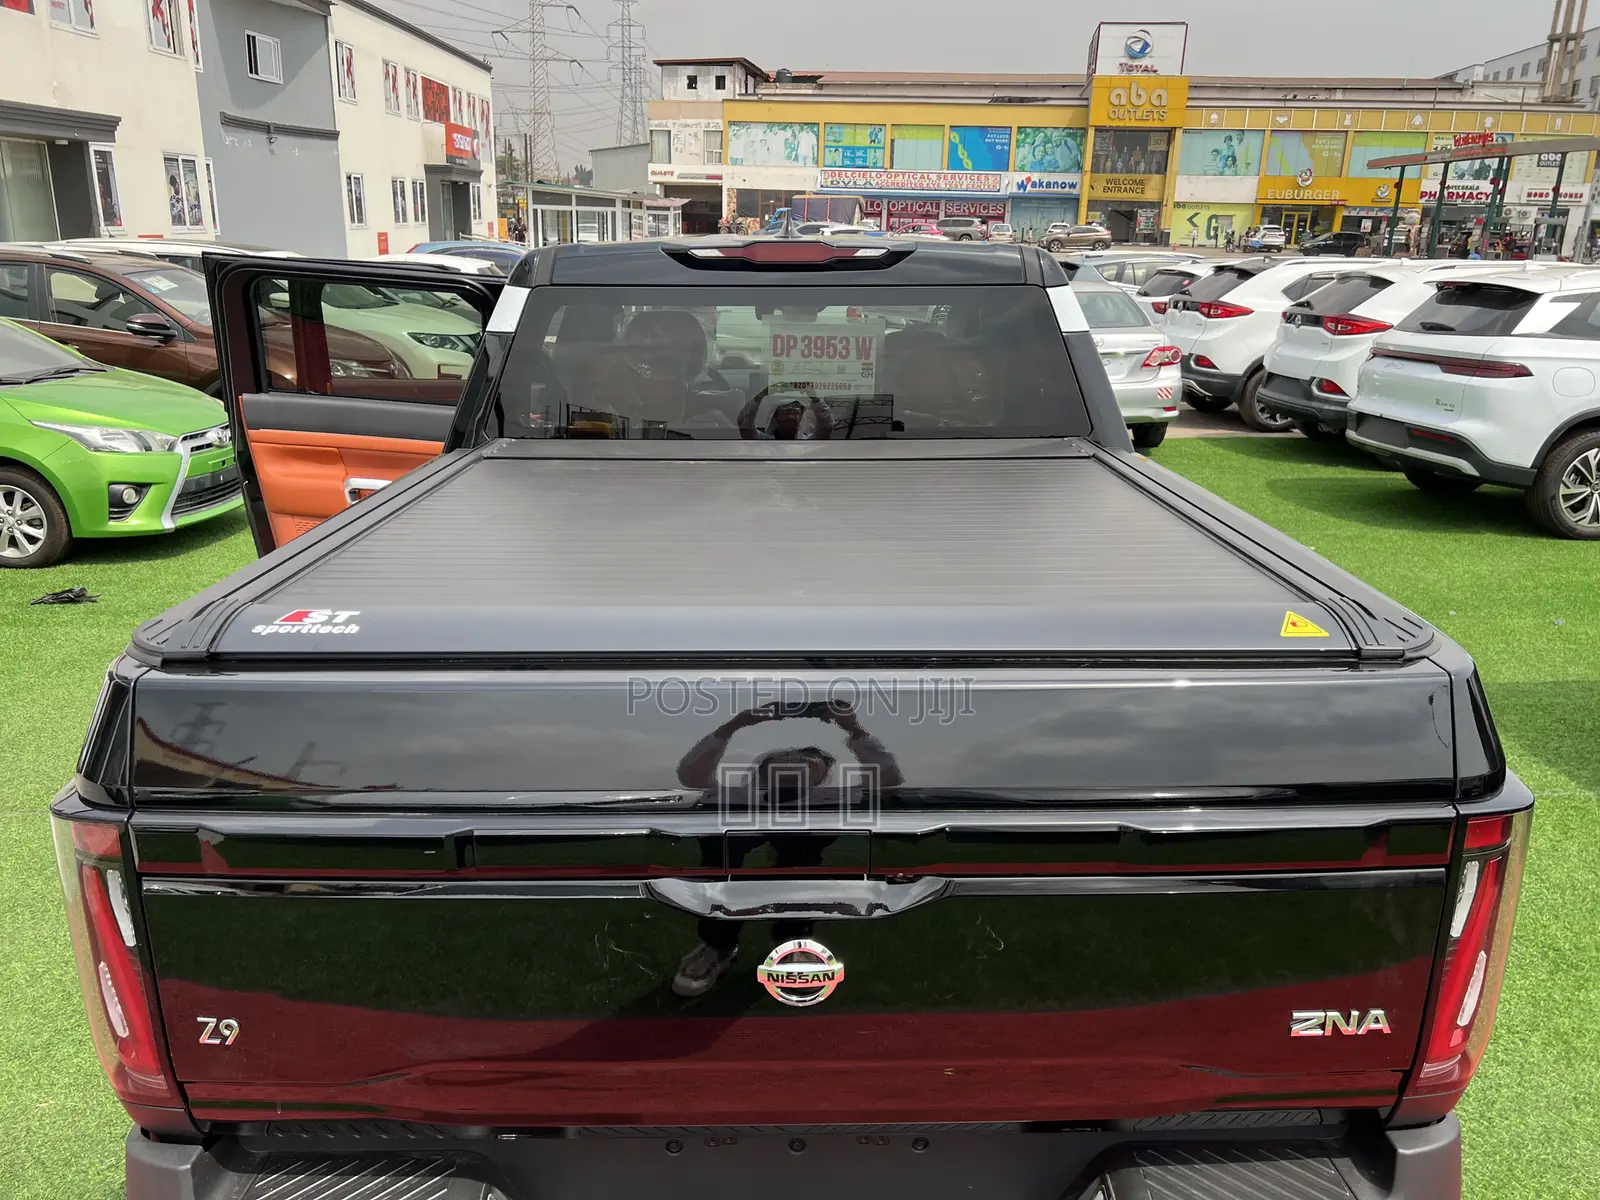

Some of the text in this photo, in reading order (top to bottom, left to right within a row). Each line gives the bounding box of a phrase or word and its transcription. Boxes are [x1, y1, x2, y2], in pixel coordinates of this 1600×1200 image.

[1119, 62, 1158, 73] TOTAL
[1109, 80, 1168, 107] aba
[1109, 108, 1167, 120] OUTLETS
[830, 171, 882, 179] DELCIELO
[886, 172, 932, 180] OPTICAL
[1016, 177, 1077, 192] Wakanow
[1105, 178, 1146, 187] WELCOME
[1102, 186, 1146, 195] ENTRANCE
[1267, 189, 1341, 200] EUBURGER
[889, 201, 940, 212] OPTICAL
[945, 203, 1004, 214] SERVICES
[772, 333, 874, 361] DP 3953 W
[251, 624, 360, 635] sporttech
[767, 972, 835, 984] NISSAN
[1289, 1008, 1392, 1037] ZNA
[196, 1016, 240, 1046] Z9
